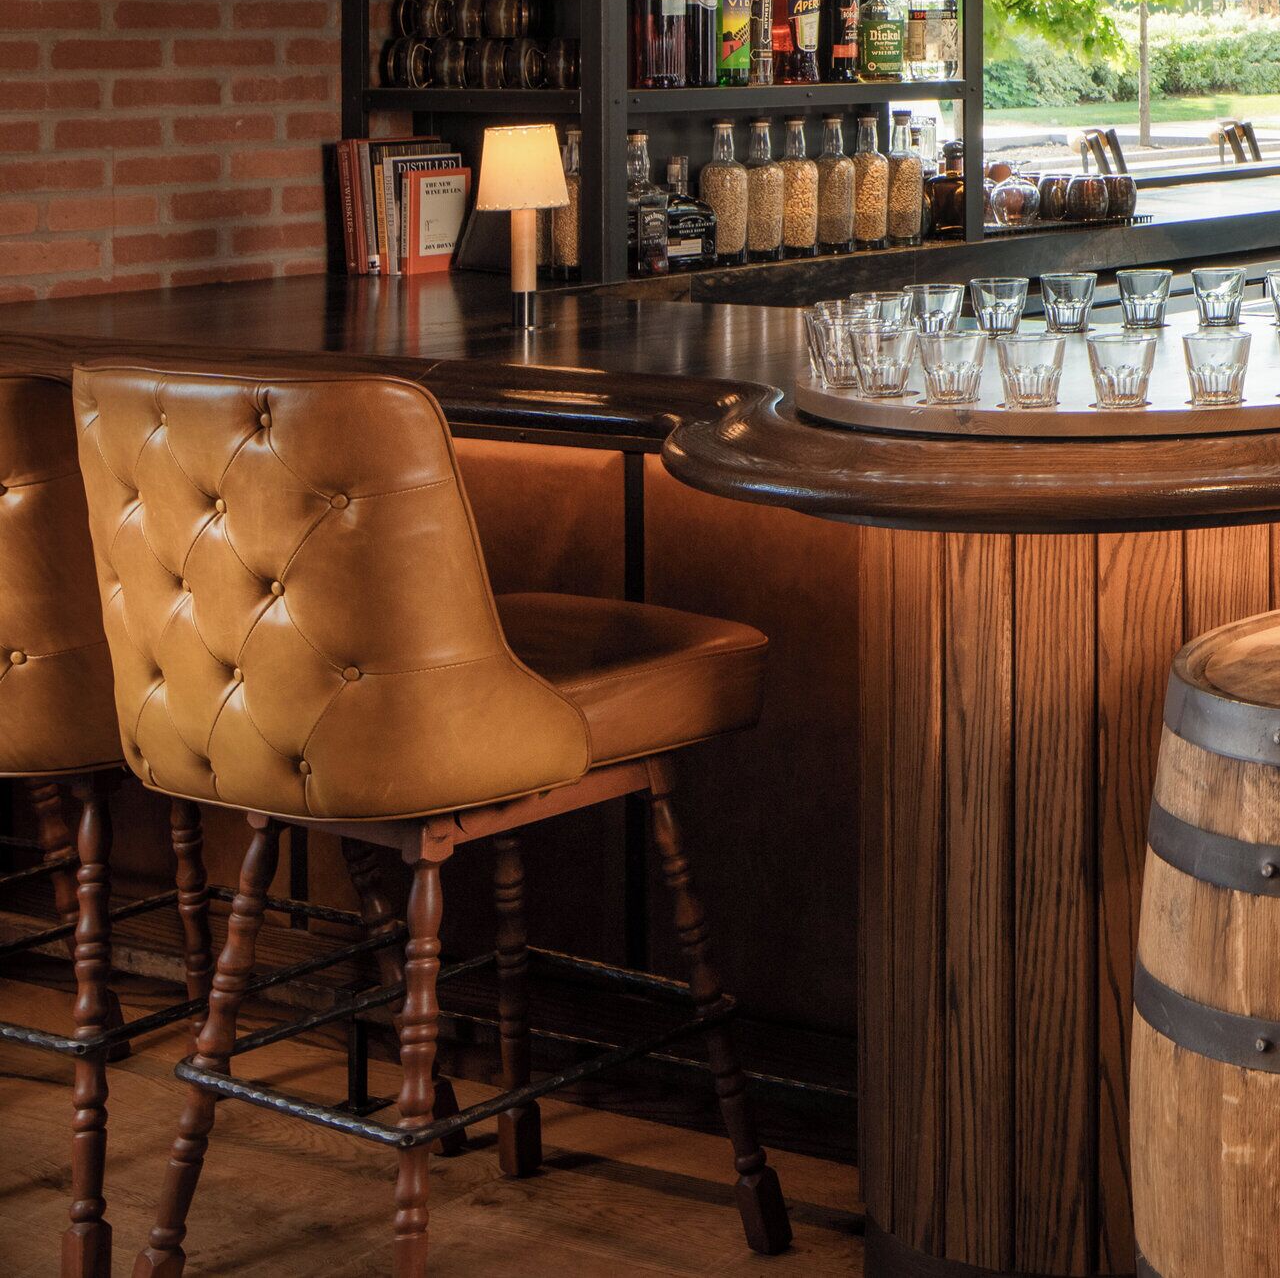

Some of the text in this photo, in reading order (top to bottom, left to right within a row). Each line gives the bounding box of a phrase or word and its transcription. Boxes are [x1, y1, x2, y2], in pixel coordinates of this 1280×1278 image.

[728, 0, 750, 7] VID
[869, 30, 900, 40] Dickel
[398, 160, 456, 173] DISTILLED
[385, 175, 394, 227] DISTILLED
